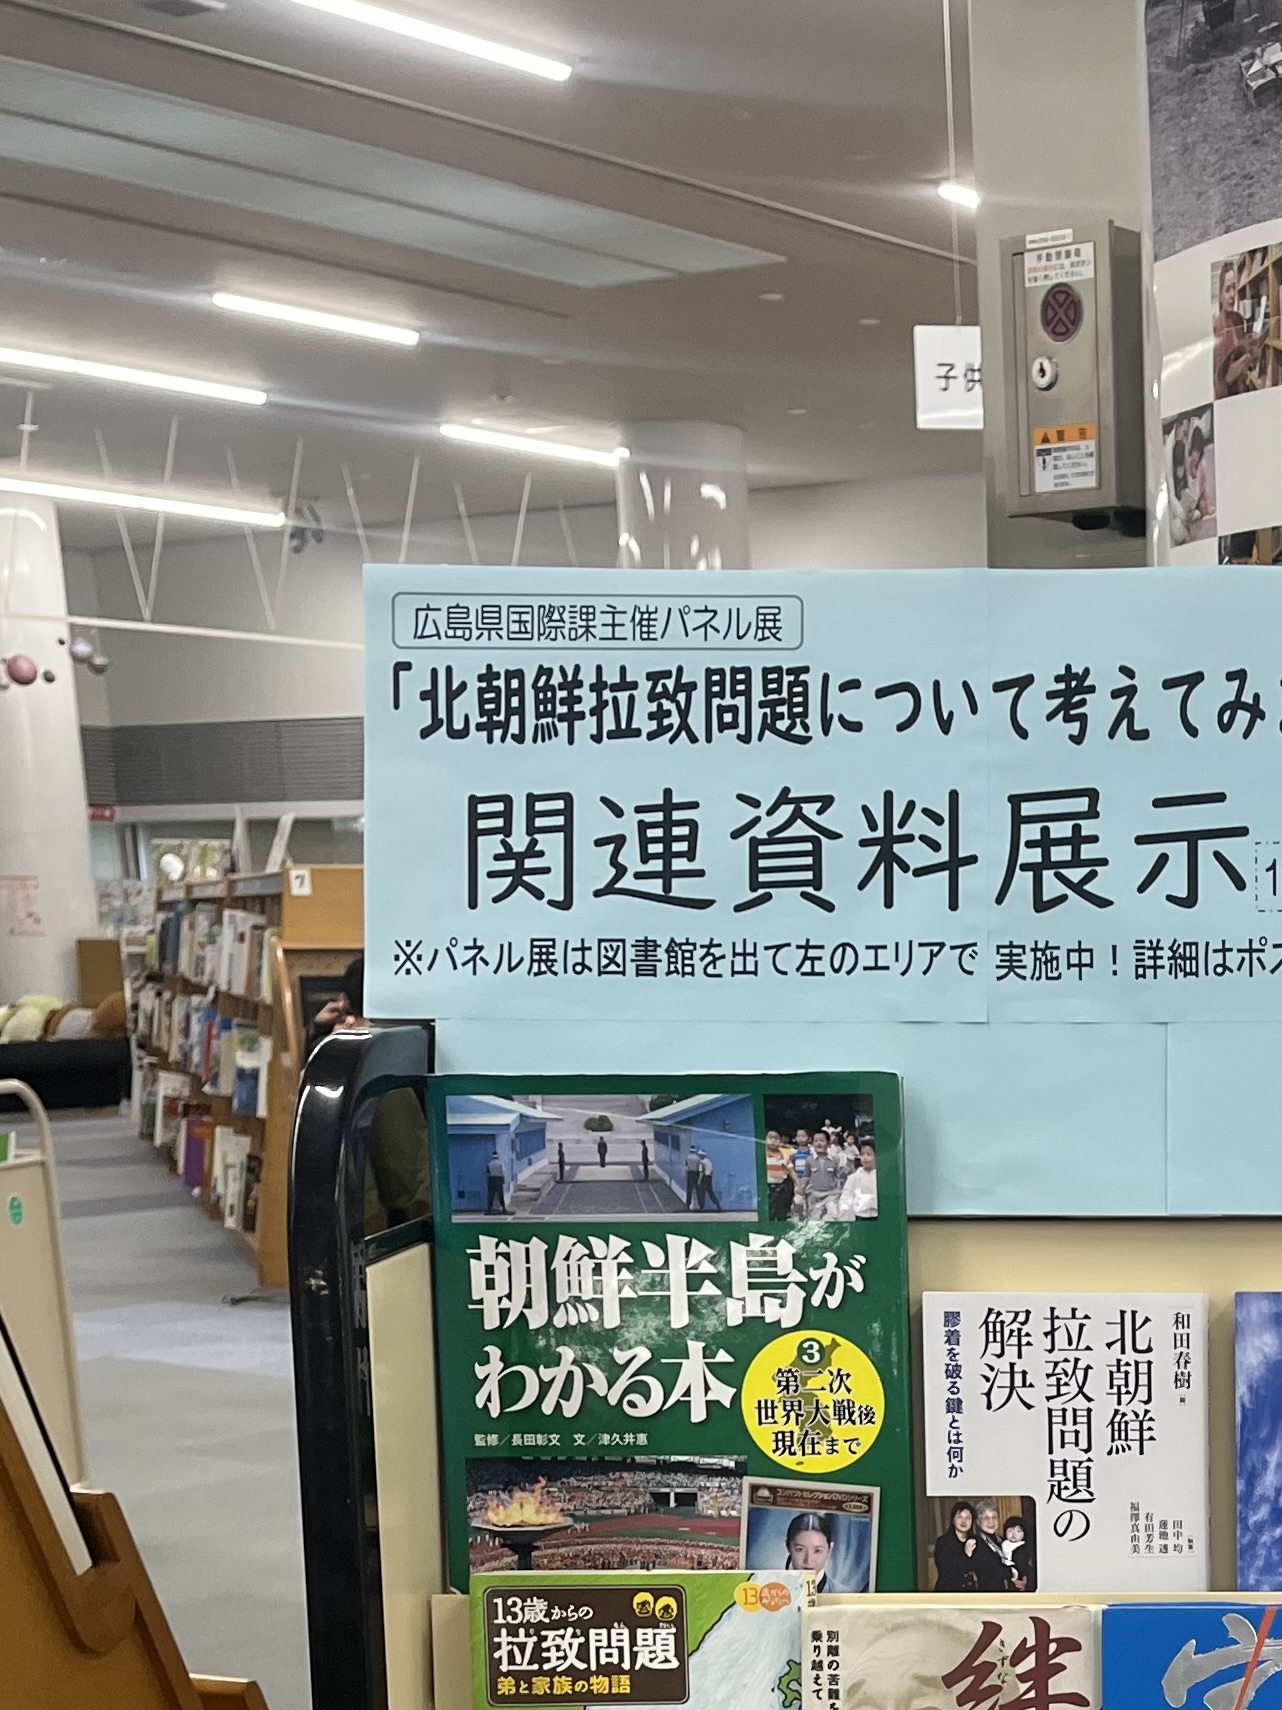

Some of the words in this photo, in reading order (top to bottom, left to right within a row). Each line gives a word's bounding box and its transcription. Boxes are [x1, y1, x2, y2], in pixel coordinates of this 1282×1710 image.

[413, 604, 783, 643] 広島県国際課主催パネル展
[467, 786, 1250, 914] 関連資料展示
[466, 1232, 866, 1330] 朝鮮半島が
[474, 1339, 737, 1423] わかる本
[775, 1368, 852, 1394] 第二次
[802, 1341, 820, 1363] 3
[978, 1307, 1035, 1412] 解決
[1105, 1309, 1156, 1456] 北朝鮮
[1172, 1312, 1192, 1390] 和田春樹
[755, 1398, 876, 1427] 世界大戦後
[943, 1310, 964, 1479] 膠着を破る鍵とは何か
[1043, 1306, 1096, 1542] 拉致問題の
[772, 1429, 861, 1457] 現在まで
[492, 1597, 594, 1624] 13歳からの
[492, 1628, 681, 1672] 拉致問題
[811, 1630, 823, 1700] 乗り越えて
[497, 1675, 631, 1696] 弟と家族の物語
